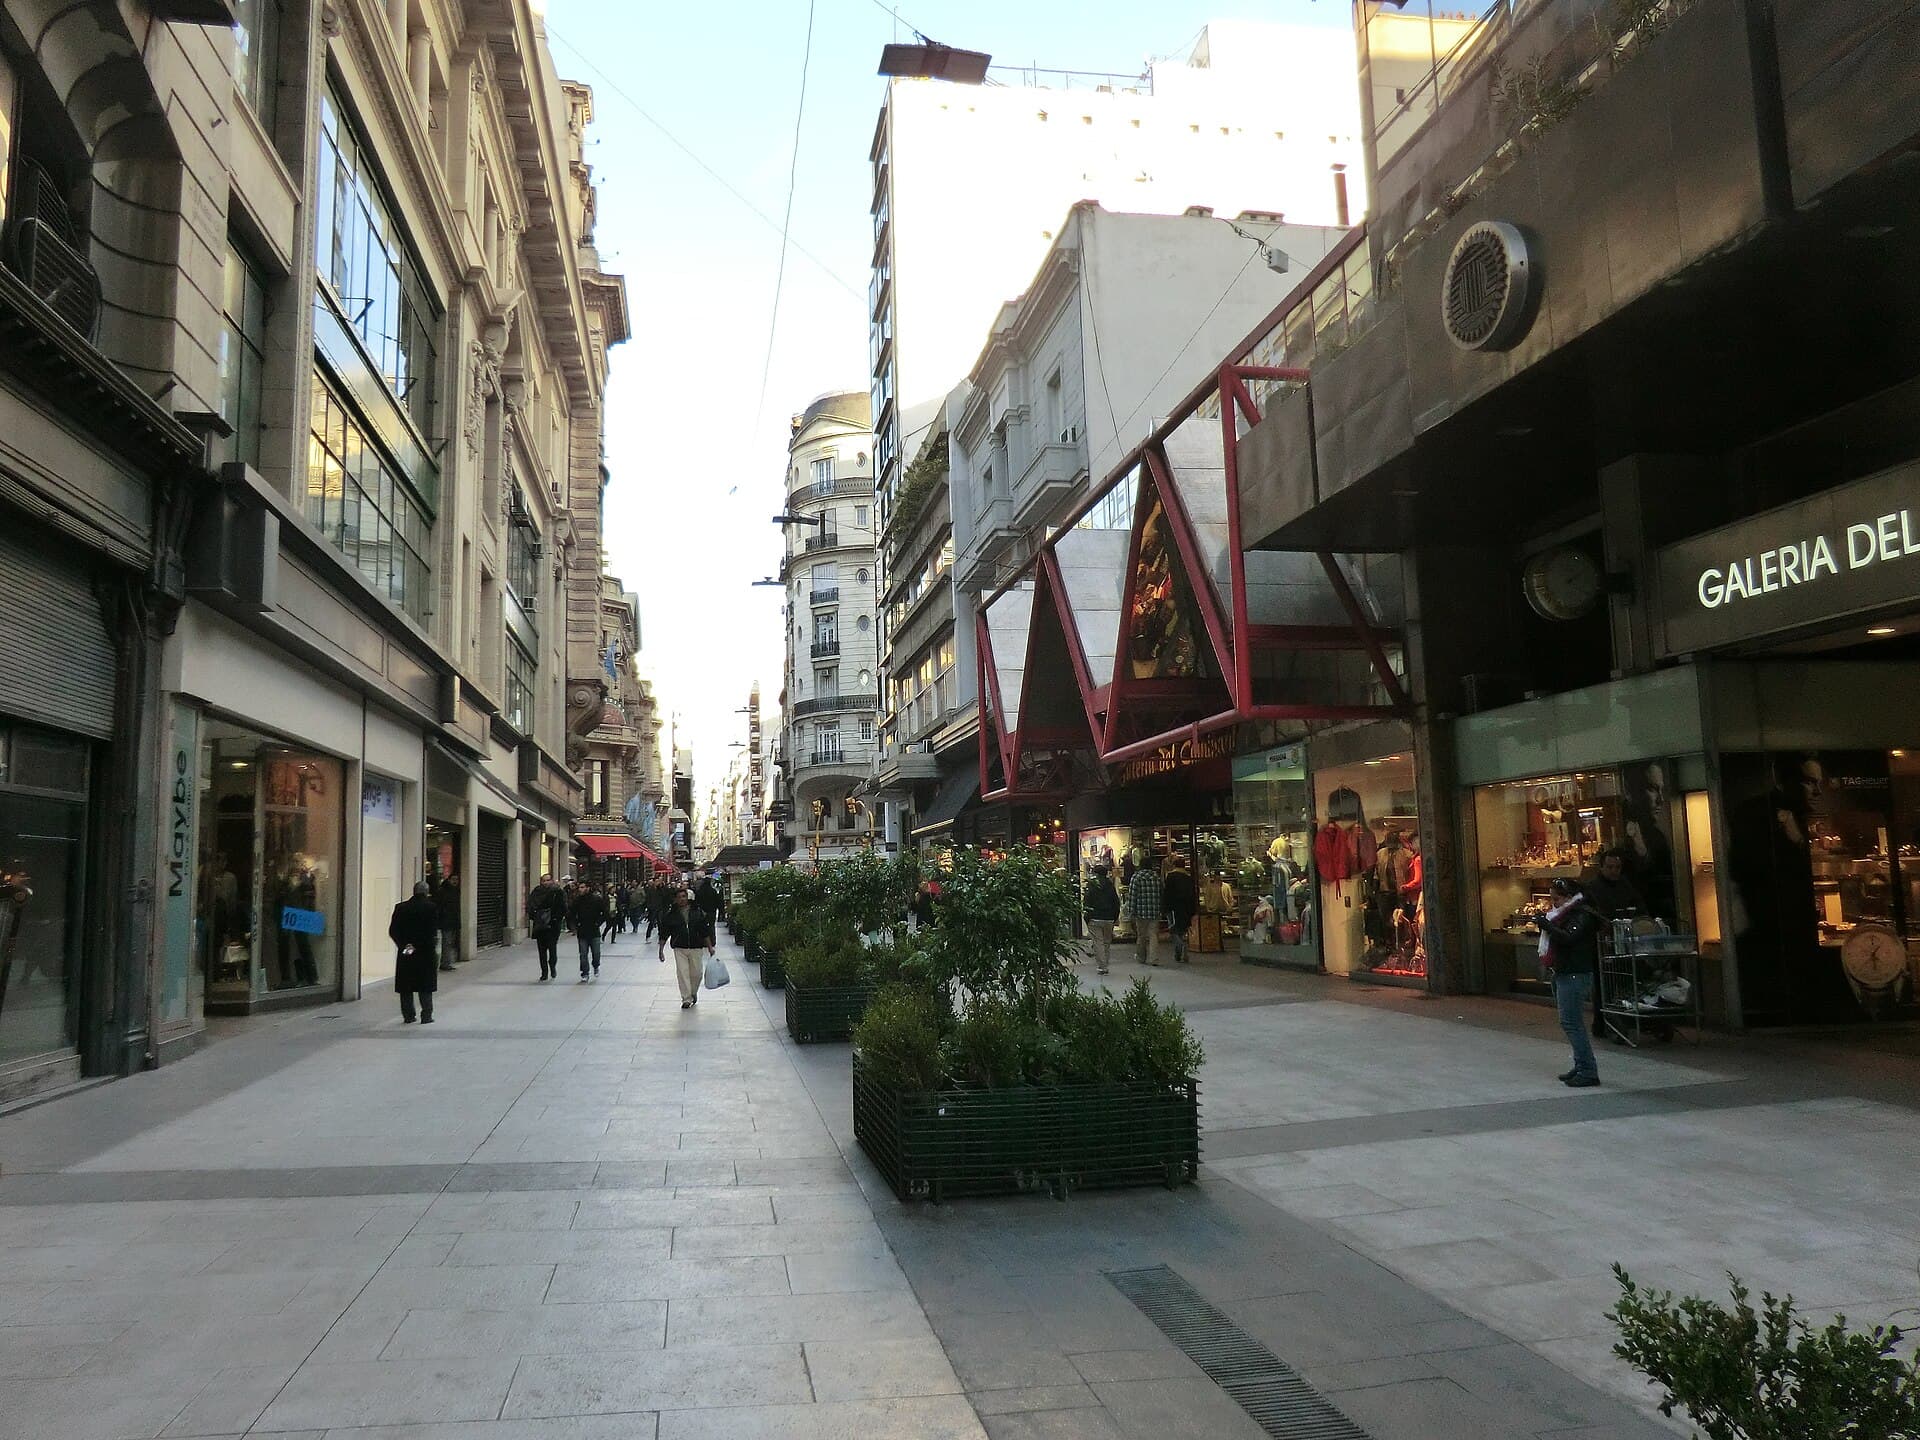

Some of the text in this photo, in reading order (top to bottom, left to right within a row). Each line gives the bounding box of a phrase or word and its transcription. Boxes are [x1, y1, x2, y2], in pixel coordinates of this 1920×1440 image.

[1698, 510, 1920, 609] GALERIA DEL
[169, 751, 187, 897] Maybe
[284, 911, 297, 927] 10
